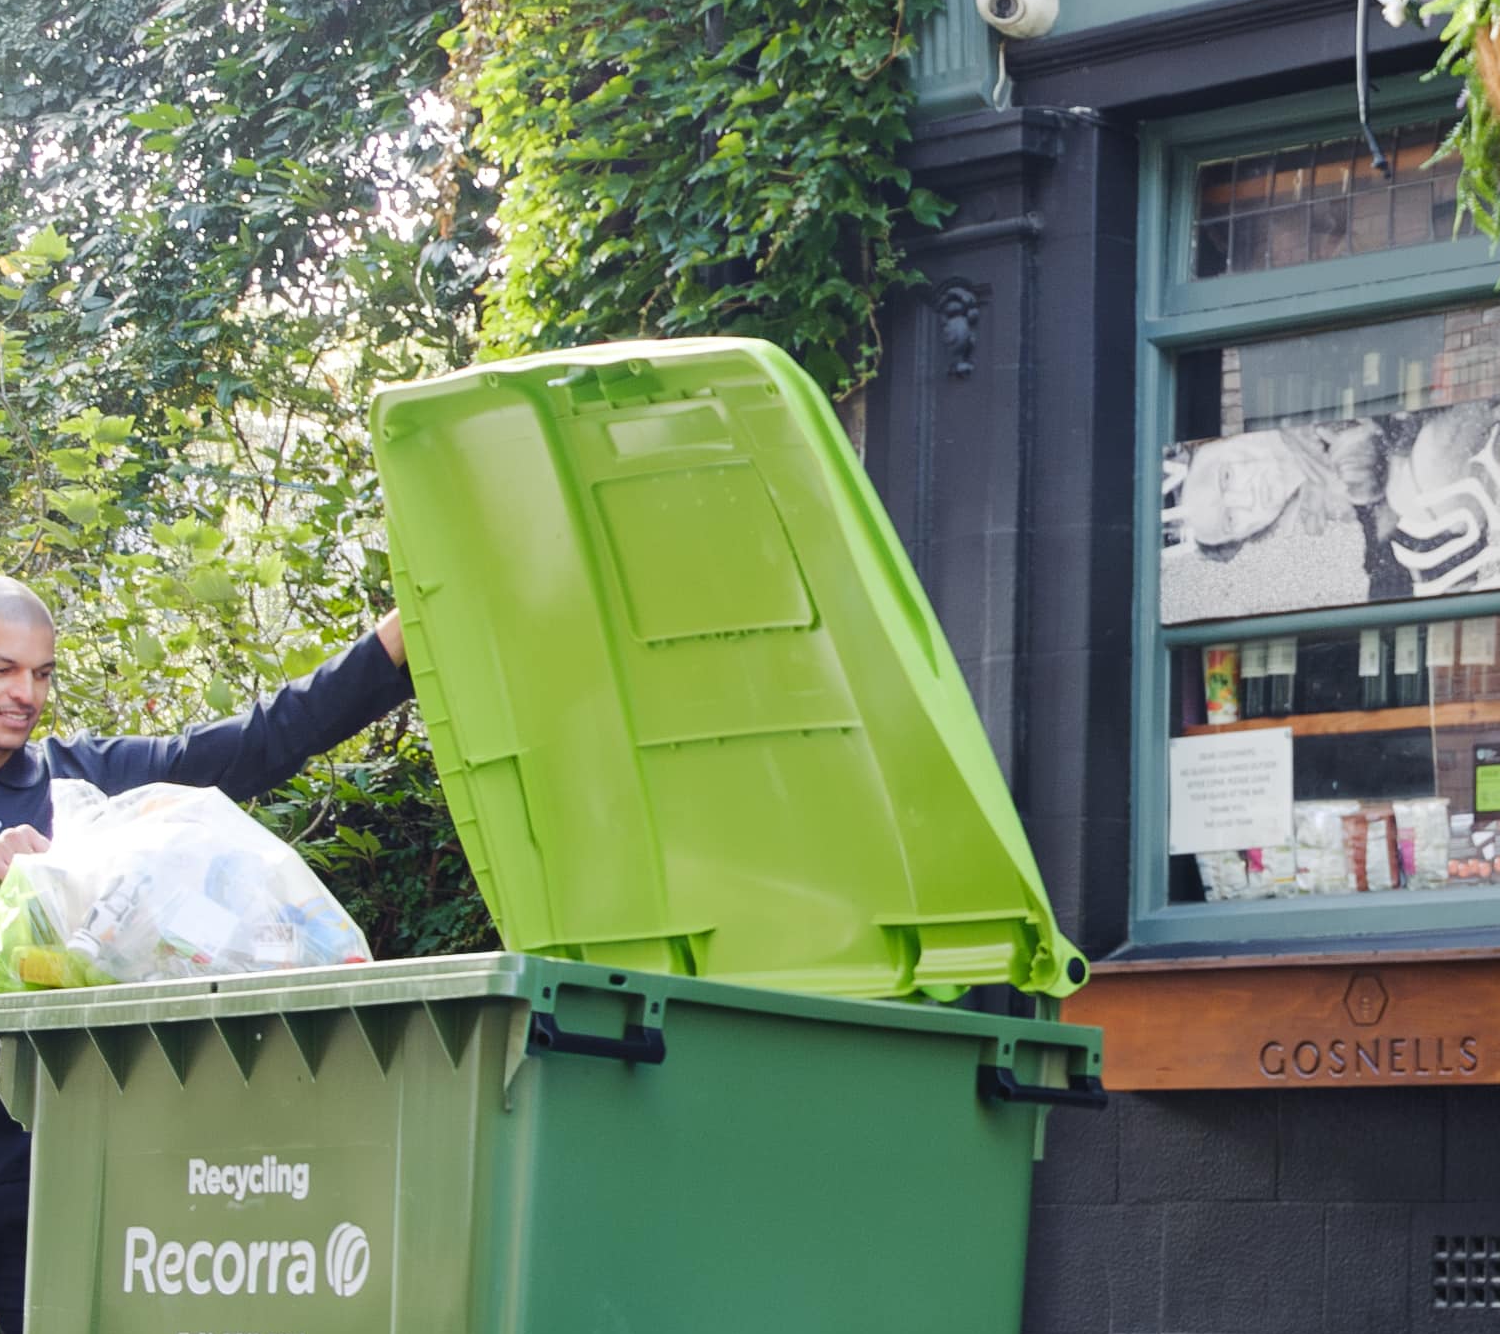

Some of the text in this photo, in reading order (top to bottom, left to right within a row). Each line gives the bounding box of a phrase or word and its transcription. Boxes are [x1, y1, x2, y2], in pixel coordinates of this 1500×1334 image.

[1259, 1036, 1480, 1080] GOSNELLS
[188, 1155, 310, 1201] Recycling
[123, 1226, 316, 1295] Recorra
